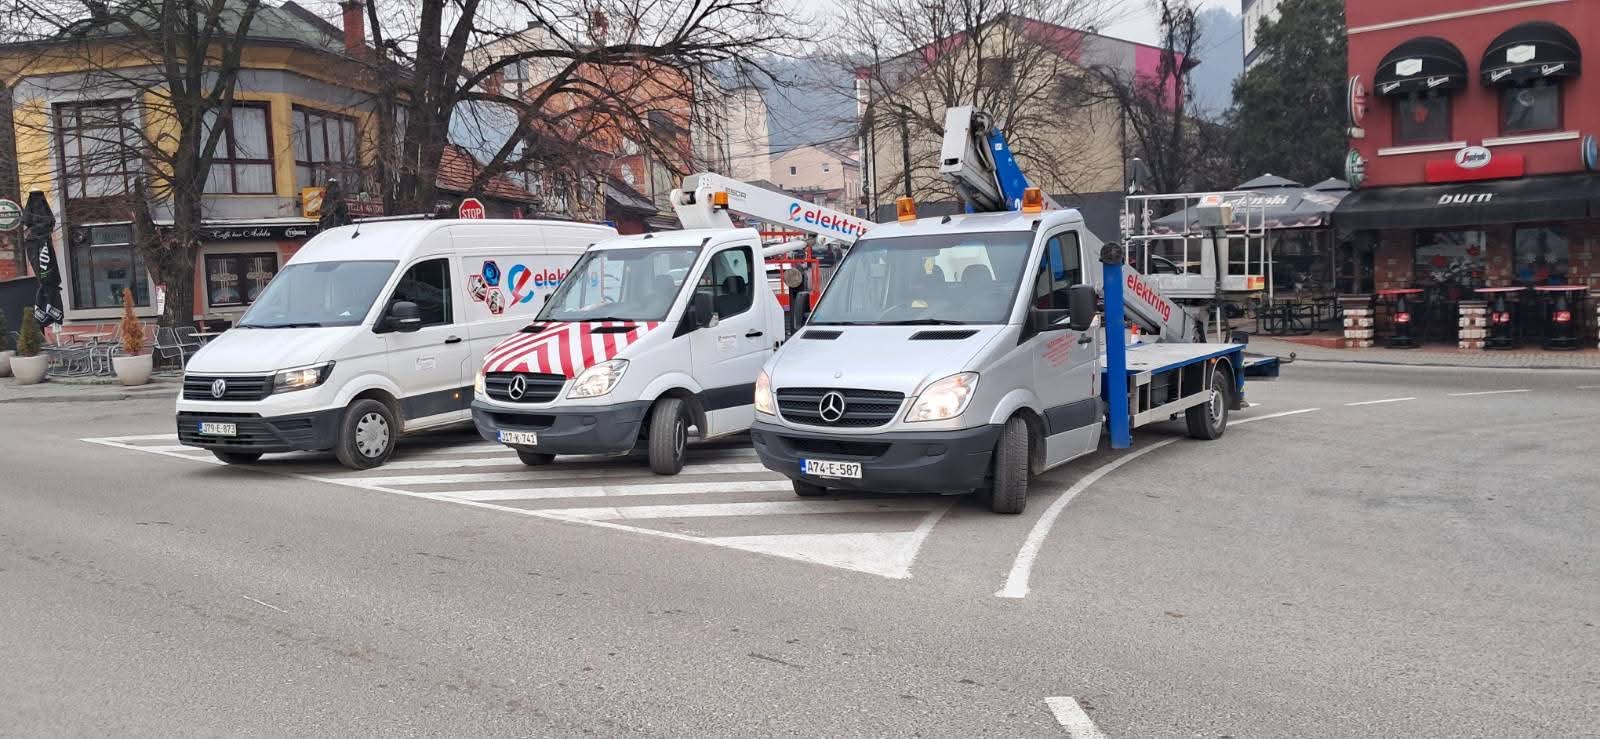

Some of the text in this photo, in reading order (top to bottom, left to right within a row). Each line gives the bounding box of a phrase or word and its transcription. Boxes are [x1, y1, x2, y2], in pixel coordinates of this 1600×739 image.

[1437, 193, 1493, 205] burn
[461, 208, 481, 219] STOP
[1127, 274, 1171, 322] elektring
[807, 460, 859, 477] A74-E-587
